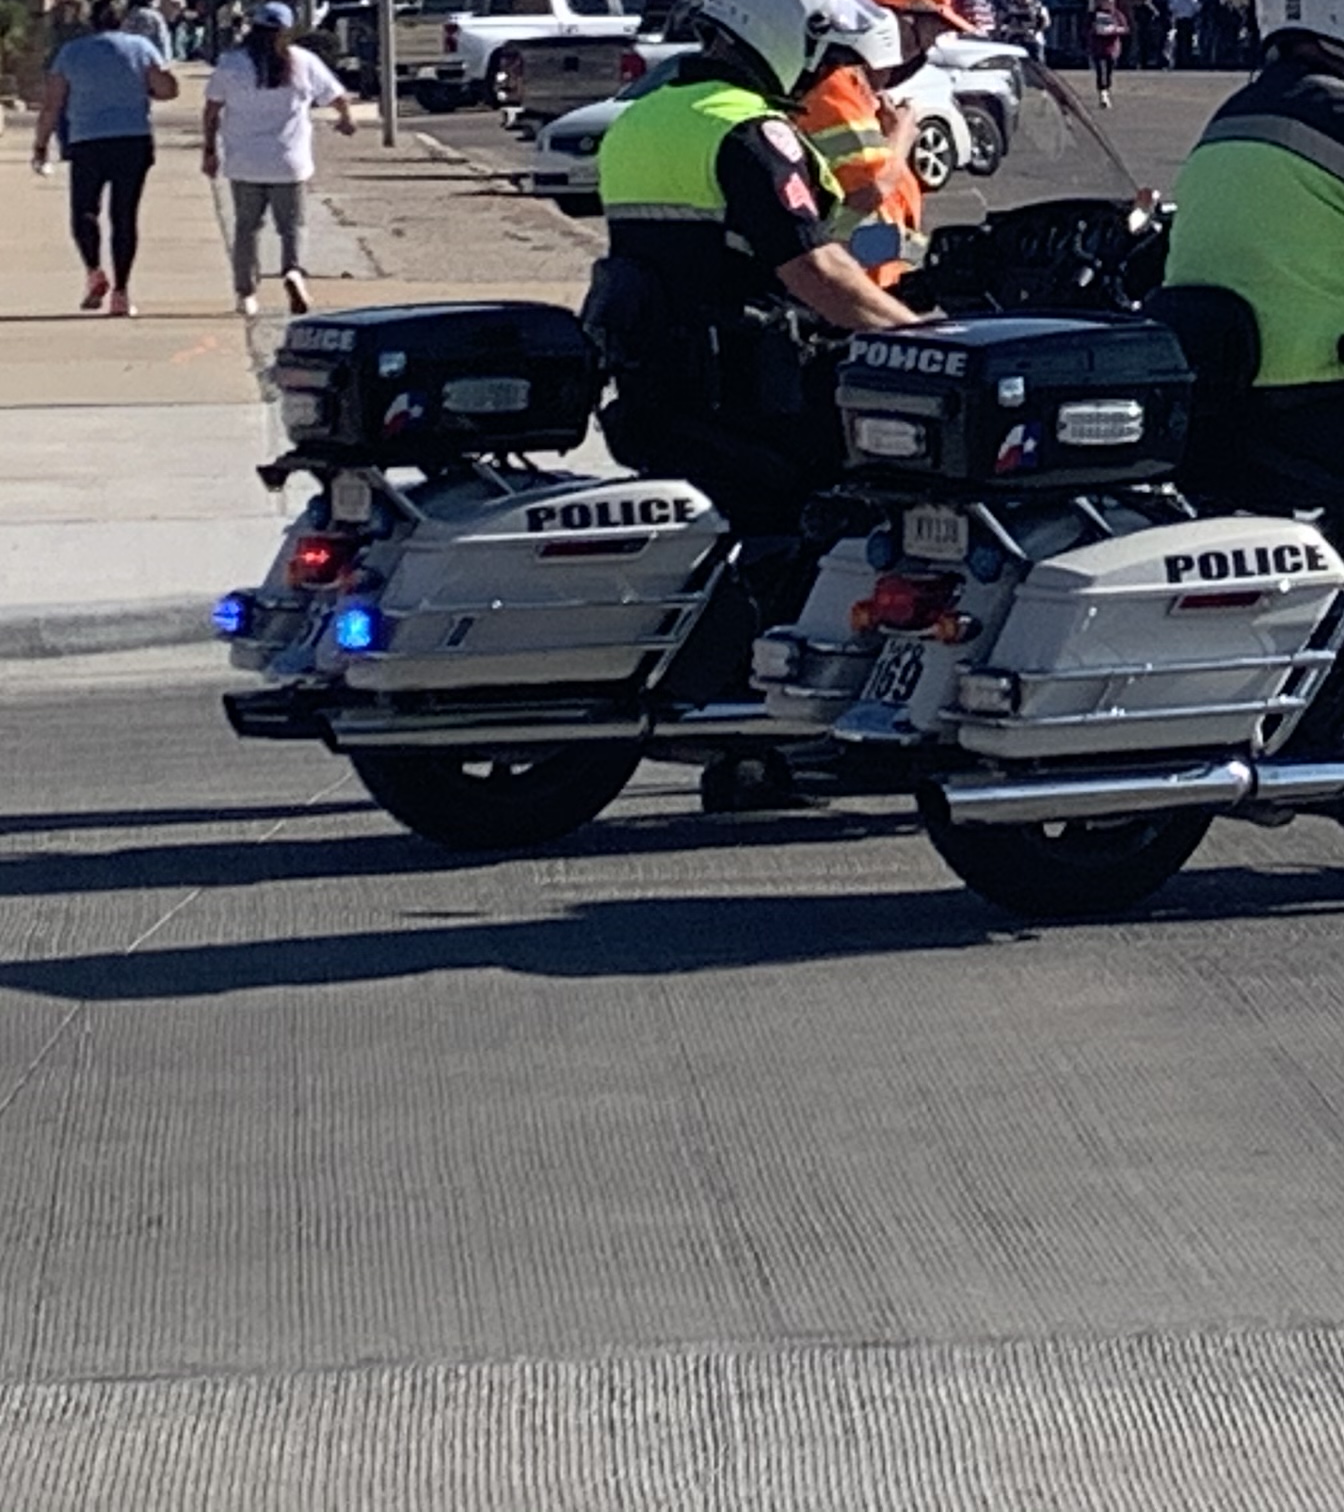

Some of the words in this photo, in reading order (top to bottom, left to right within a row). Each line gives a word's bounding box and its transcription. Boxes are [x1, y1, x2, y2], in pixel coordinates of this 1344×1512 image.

[850, 340, 968, 377] POLICE
[526, 497, 696, 532] POLICE
[1164, 544, 1329, 583] POLICE
[866, 654, 923, 701] 169
